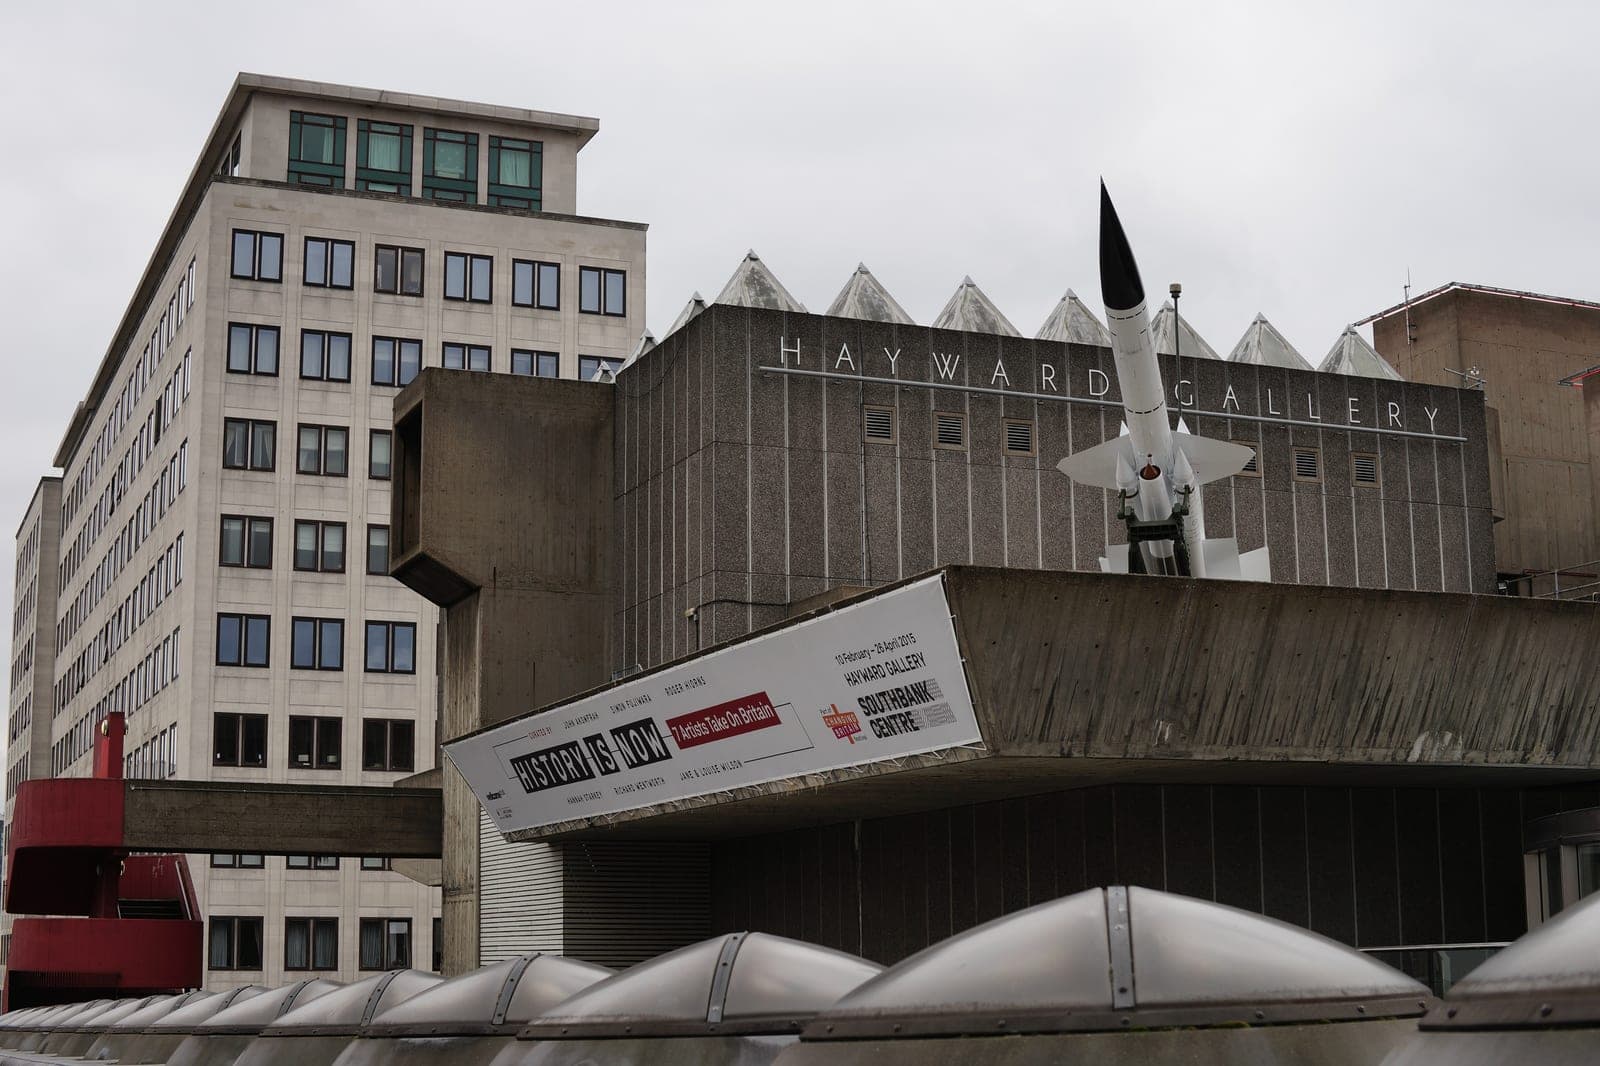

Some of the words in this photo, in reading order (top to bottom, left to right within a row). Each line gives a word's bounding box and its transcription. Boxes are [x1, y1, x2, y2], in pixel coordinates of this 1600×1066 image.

[780, 336, 1110, 396] HAYWARD
[1174, 380, 1438, 432] GALLERY
[835, 655, 844, 666] 10
[844, 649, 871, 662] February
[874, 643, 884, 654] 26
[884, 638, 900, 652] April
[898, 633, 916, 648] 2015
[844, 664, 886, 687] HAYWARD
[885, 652, 926, 676] GALLERY
[857, 680, 935, 717] SOUTHBANK
[672, 727, 682, 743] 7
[680, 719, 709, 741] Artists
[705, 713, 728, 732] Take
[726, 708, 744, 727] On
[742, 701, 774, 724] Britain
[869, 710, 920, 739] CENTRE
[514, 745, 589, 791] HISTORY
[588, 739, 614, 772] IS
[614, 723, 667, 769] NOW
